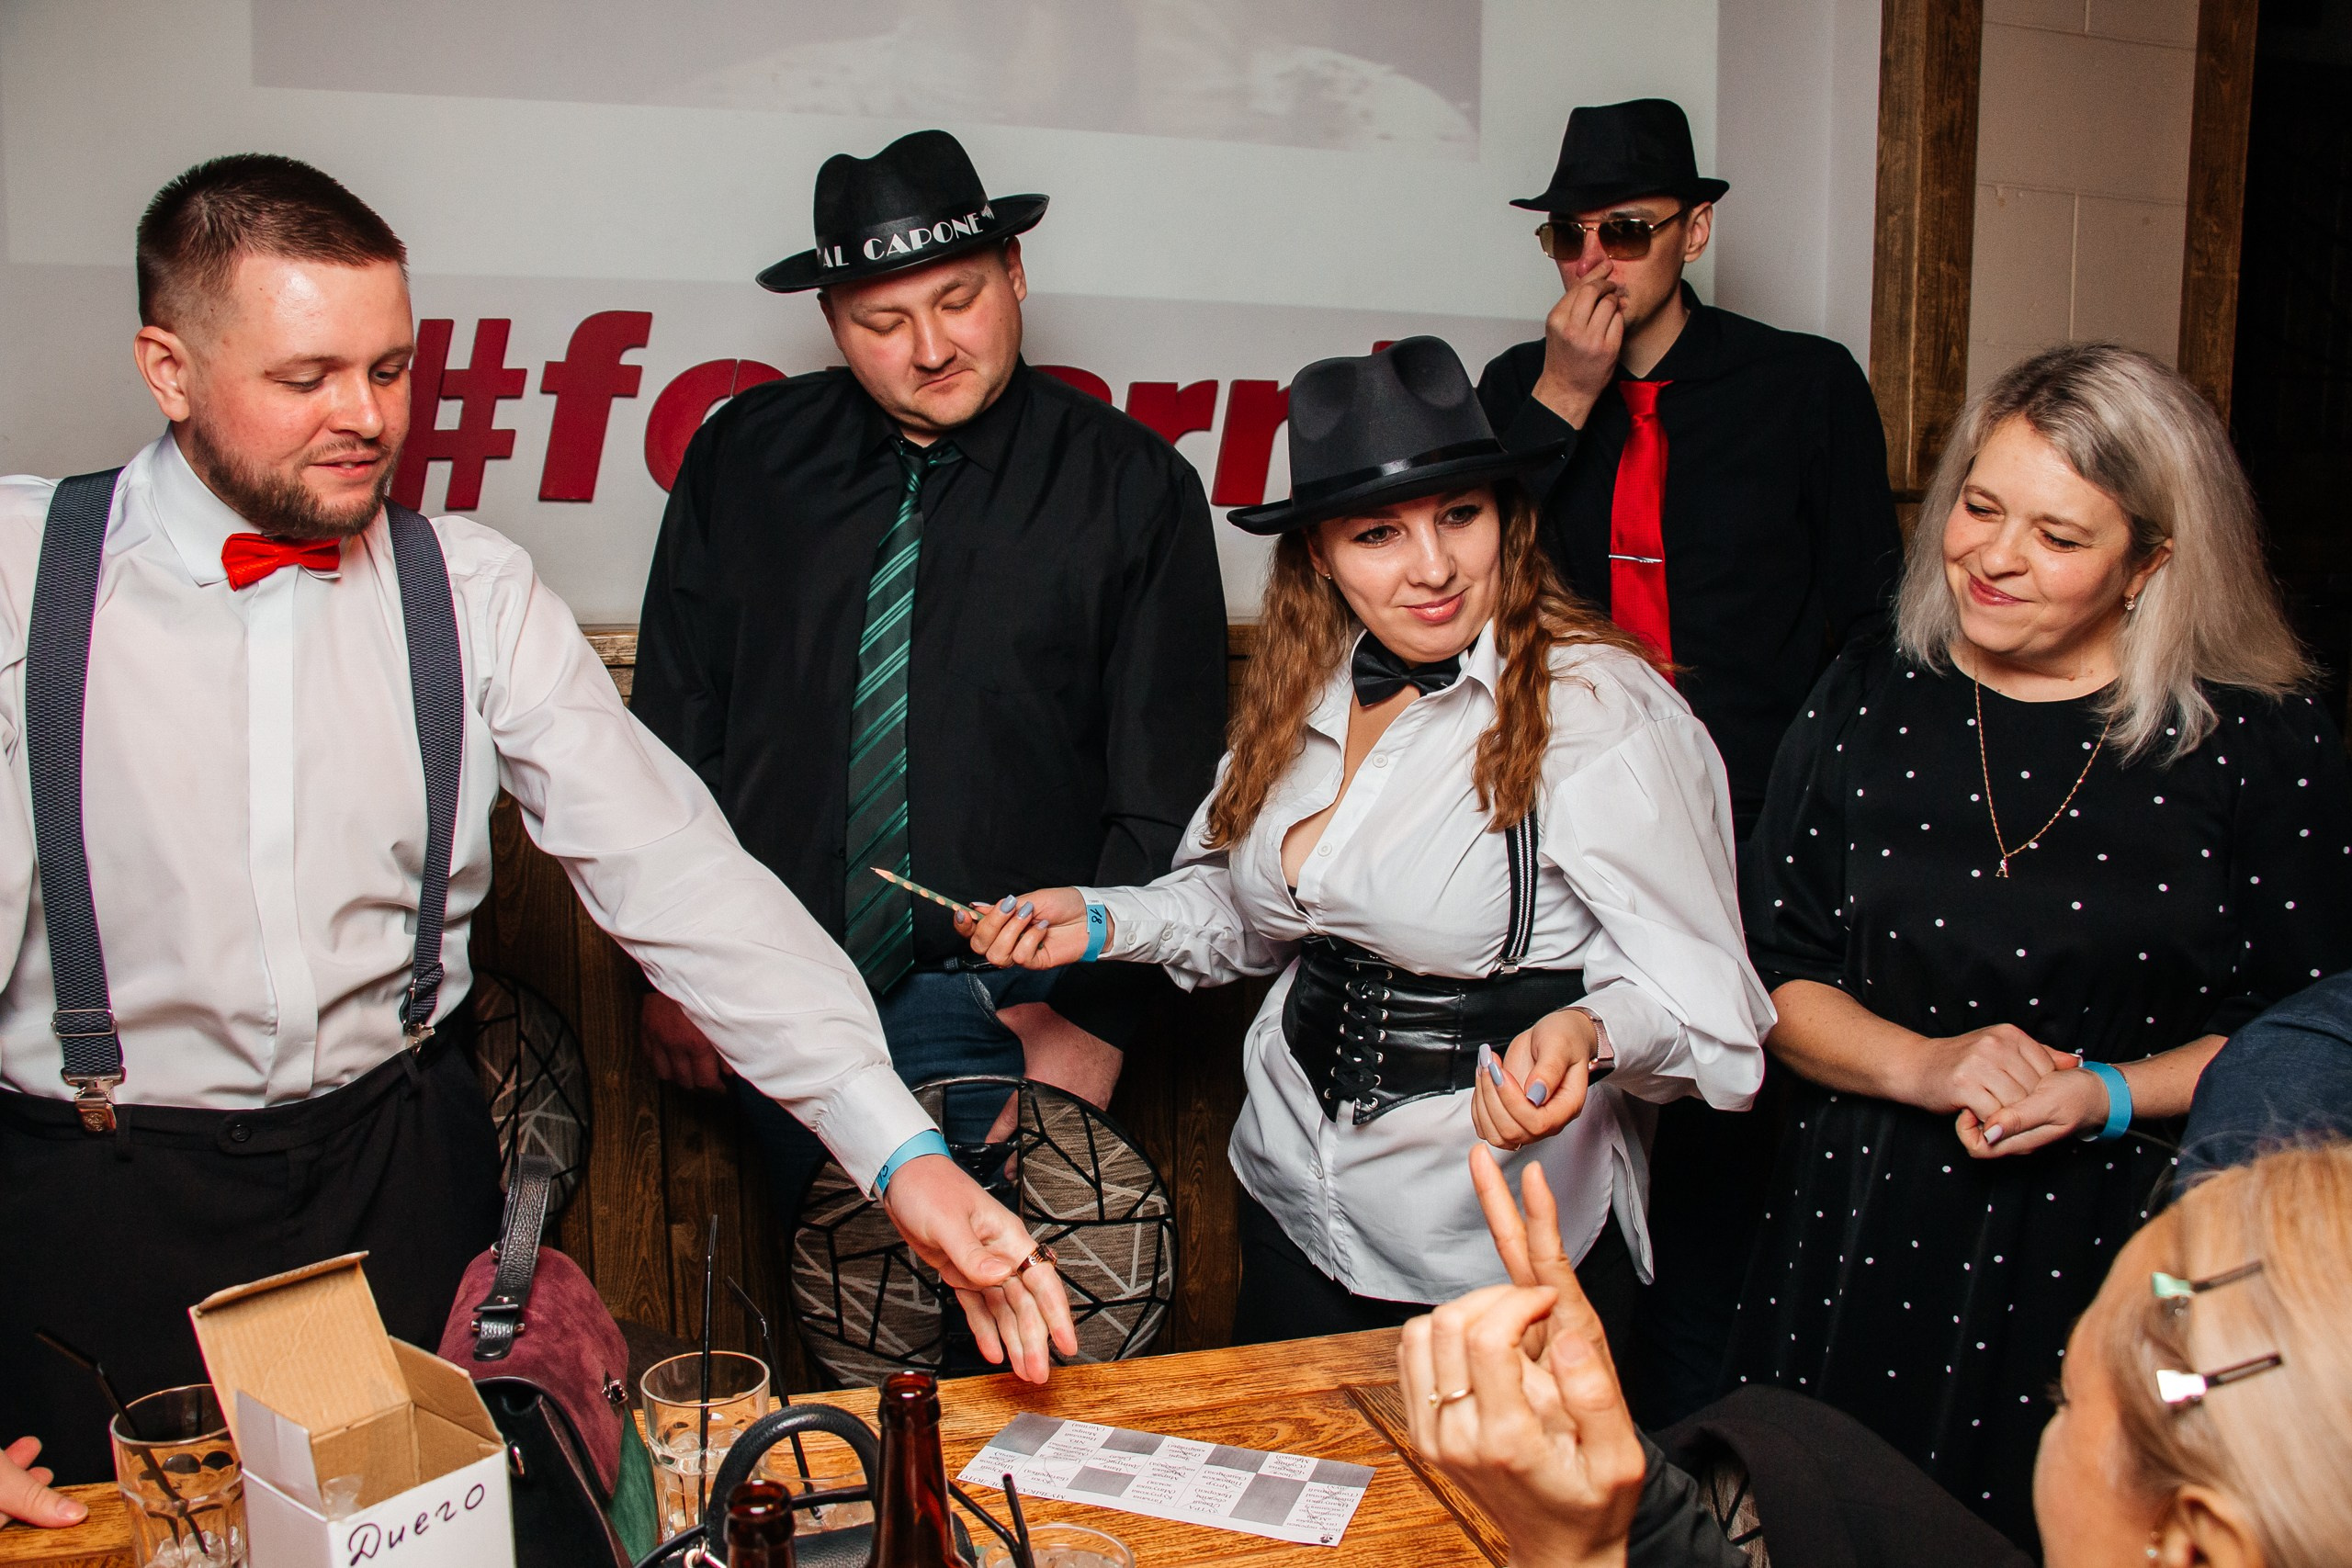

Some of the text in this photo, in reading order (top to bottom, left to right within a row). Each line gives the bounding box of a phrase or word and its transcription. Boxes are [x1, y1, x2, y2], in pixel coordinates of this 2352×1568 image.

[822, 213, 983, 267] AL CAPONE
[957, 1473, 1067, 1499] МУЗЫКАЛОЕ ЛОТО
[347, 1483, 485, 1567] Диего
